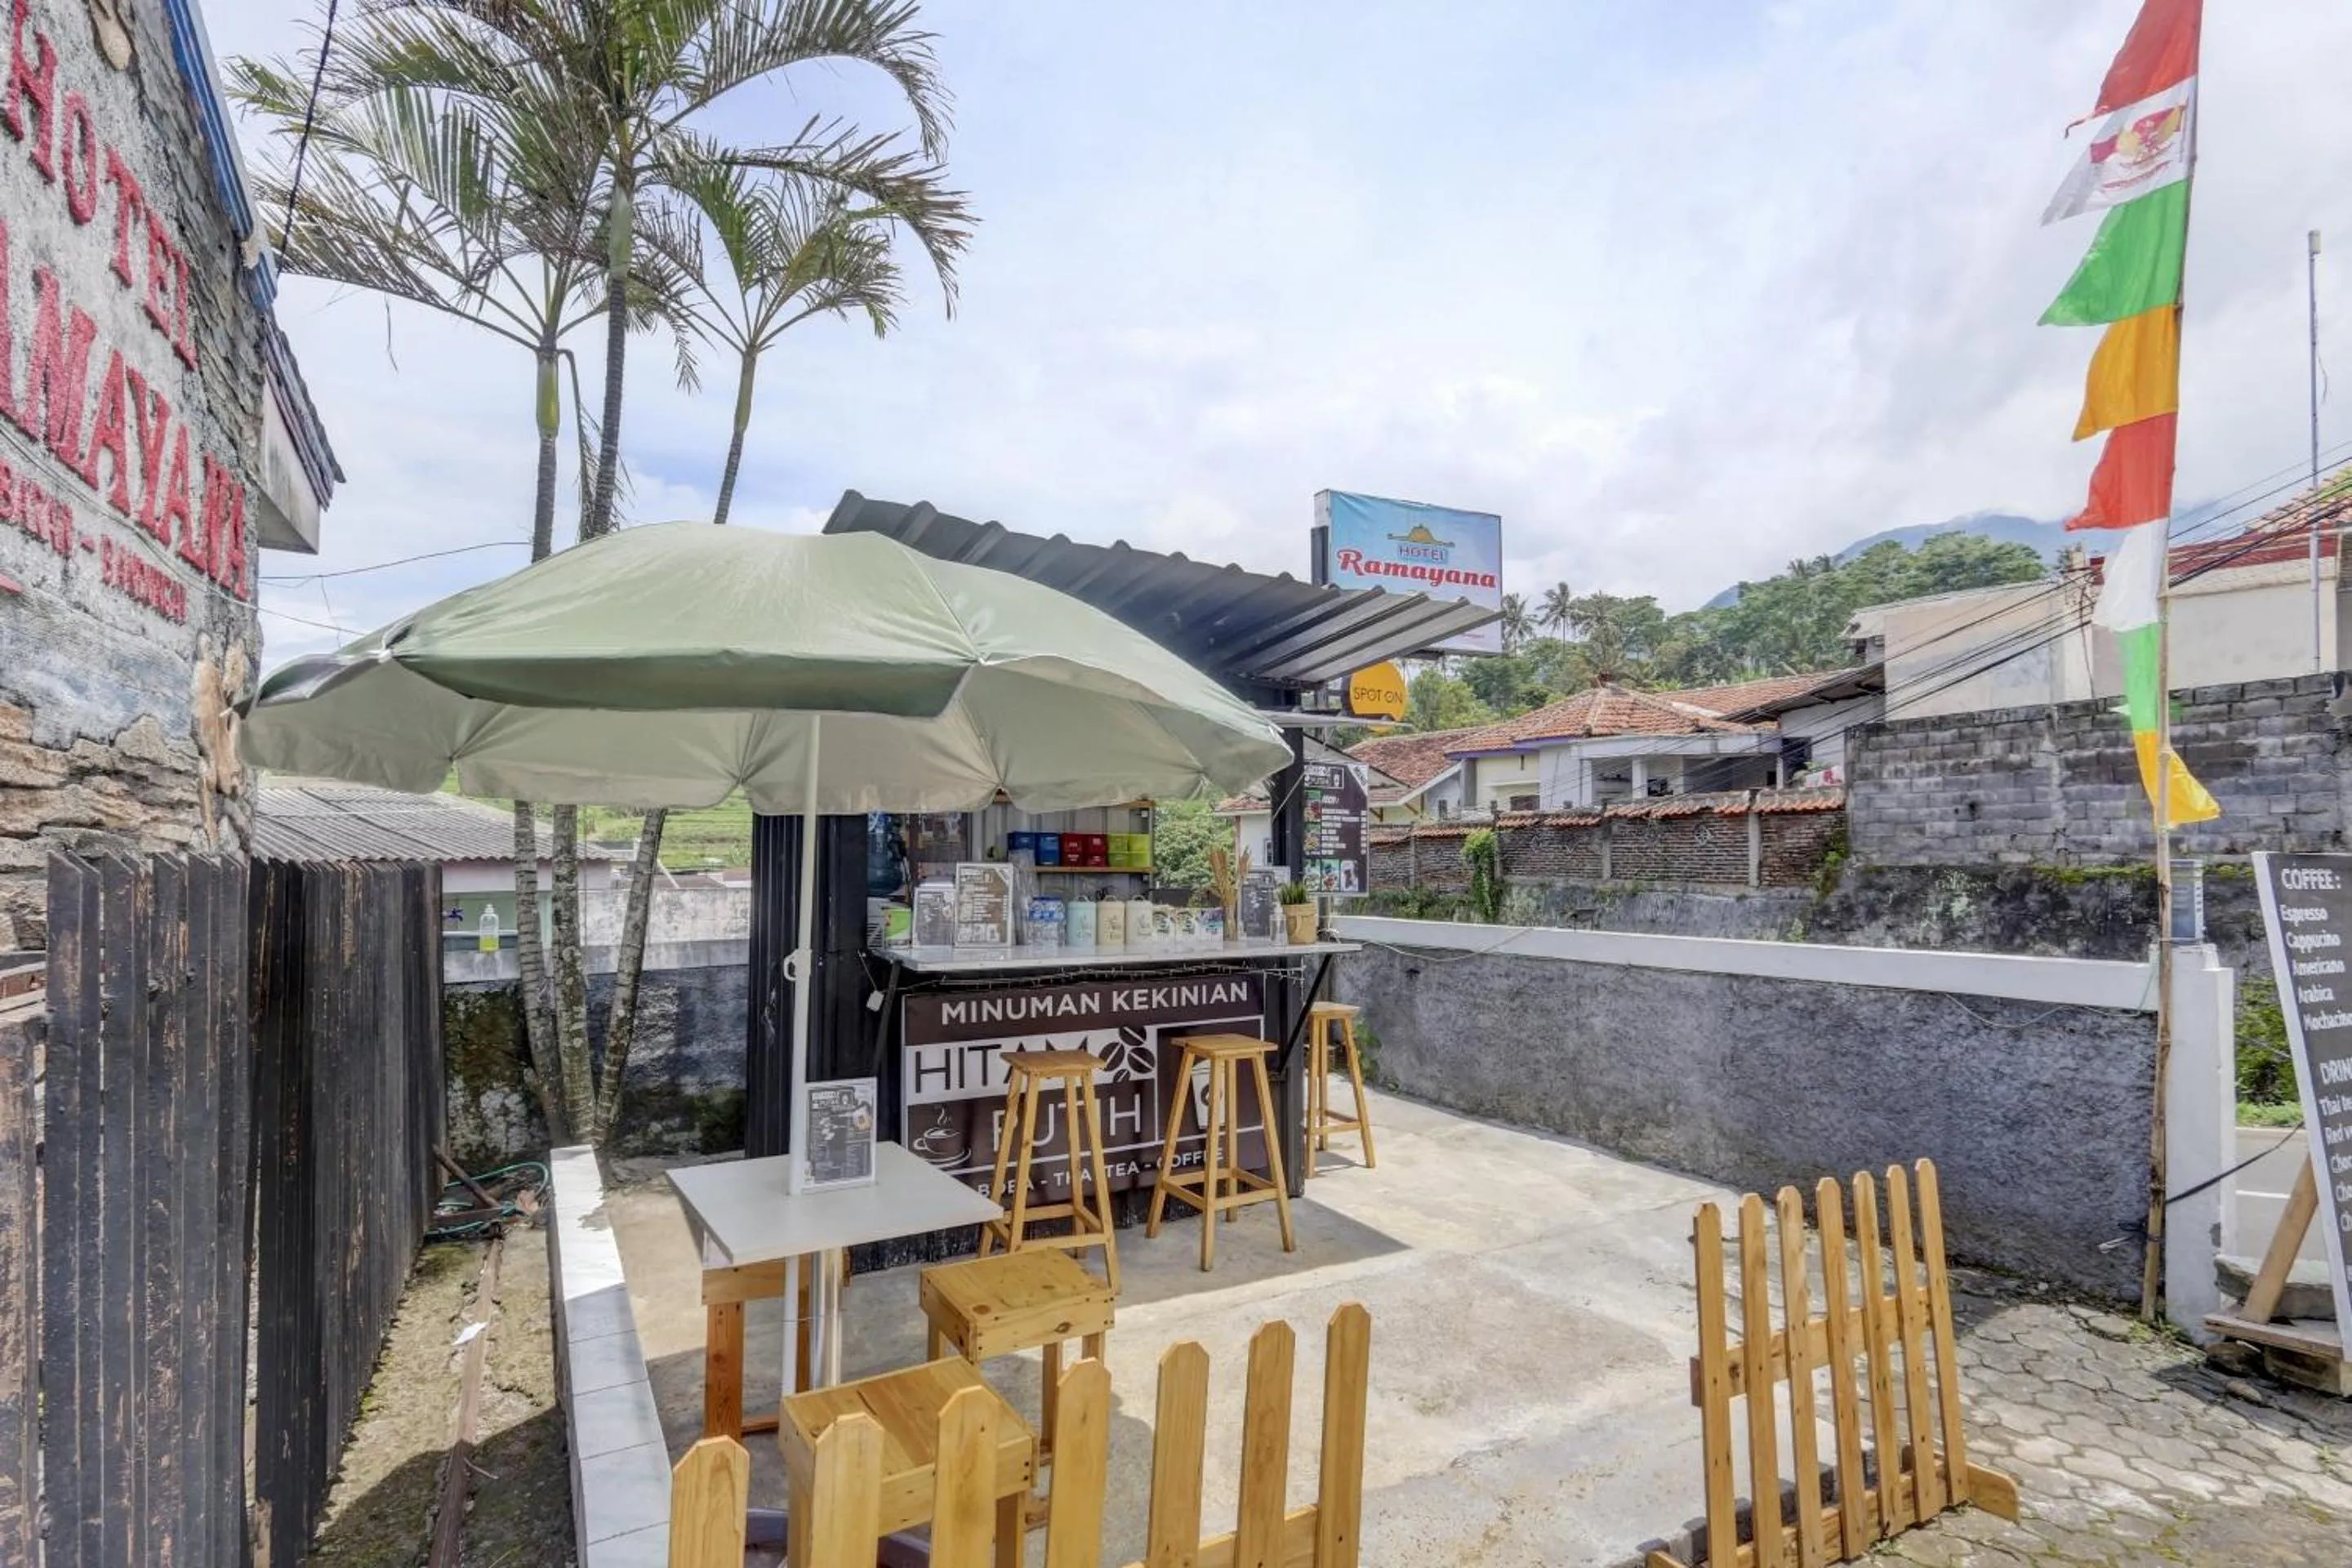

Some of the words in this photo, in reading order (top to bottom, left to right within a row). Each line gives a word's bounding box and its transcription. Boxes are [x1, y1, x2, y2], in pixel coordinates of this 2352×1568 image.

[4, 0, 198, 371] HOTEL
[1398, 545, 1445, 561] HOTEL
[1337, 548, 1496, 588] Ramayana
[1354, 687, 1383, 702] SPOT
[1384, 690, 1403, 704] ON
[2279, 904, 2328, 927] Espresso
[2292, 957, 2345, 976] Americano
[942, 992, 1100, 1025] MINUMAN
[1112, 982, 1247, 1012] KEKINIAN
[2298, 983, 2335, 1004] Arabica
[915, 1036, 1089, 1094] HIT
[993, 1093, 1141, 1152] PUIH
[2324, 1123, 2344, 1146] Red
[1104, 1161, 1140, 1178] TEA
